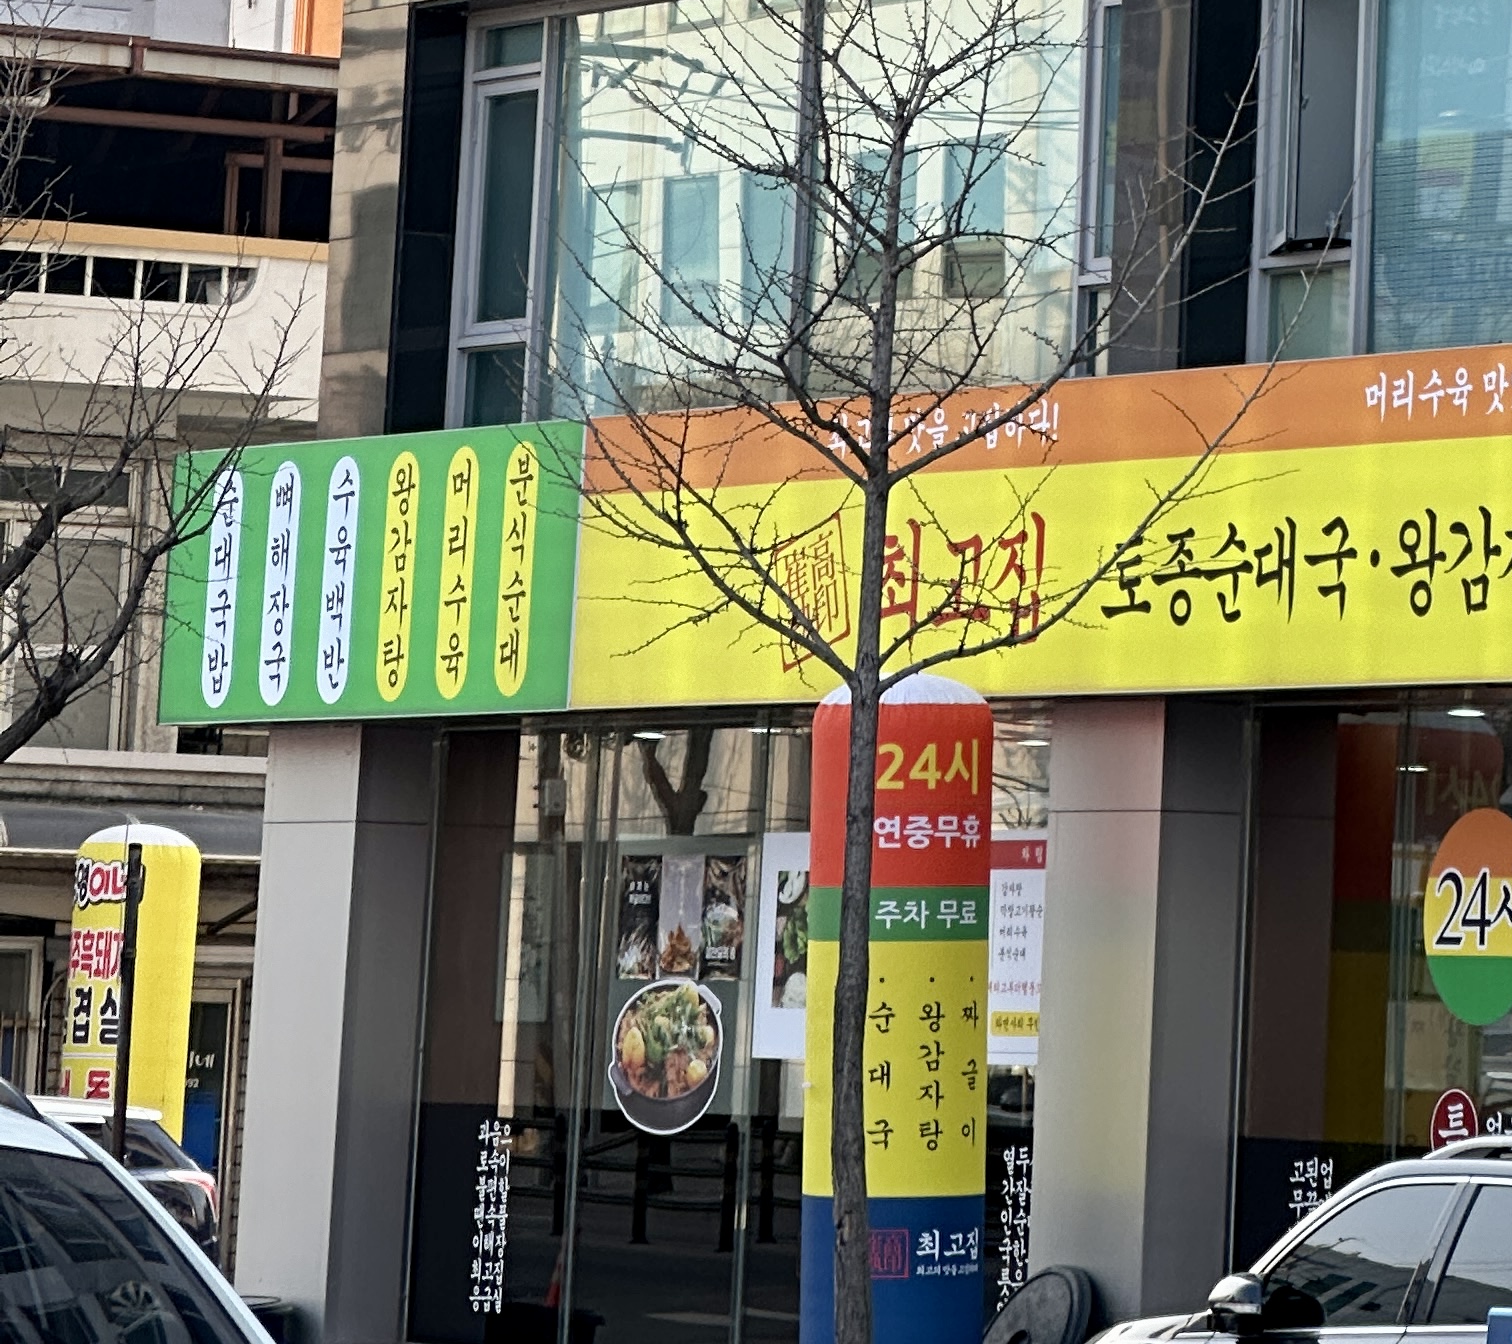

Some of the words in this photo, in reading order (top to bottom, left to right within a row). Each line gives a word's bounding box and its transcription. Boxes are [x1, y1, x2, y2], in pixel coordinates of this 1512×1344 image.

[1365, 368, 1472, 431] 머리수육
[208, 477, 240, 696] 순대국밥
[264, 471, 295, 693] 뼈해장국
[322, 468, 356, 690] 수육백반
[383, 462, 416, 688] 왕감자탕
[441, 458, 471, 686] 머리수육
[499, 453, 534, 684] 분식순대
[873, 814, 981, 850] 연중무휴
[876, 742, 979, 795] 24시
[874, 899, 929, 930] 주차
[936, 899, 978, 927] 무료
[866, 1000, 896, 1150] 순대국
[918, 1001, 945, 1152] 왕감자탕
[470, 1256, 504, 1285] 최고집
[916, 1227, 978, 1262] 최고집
